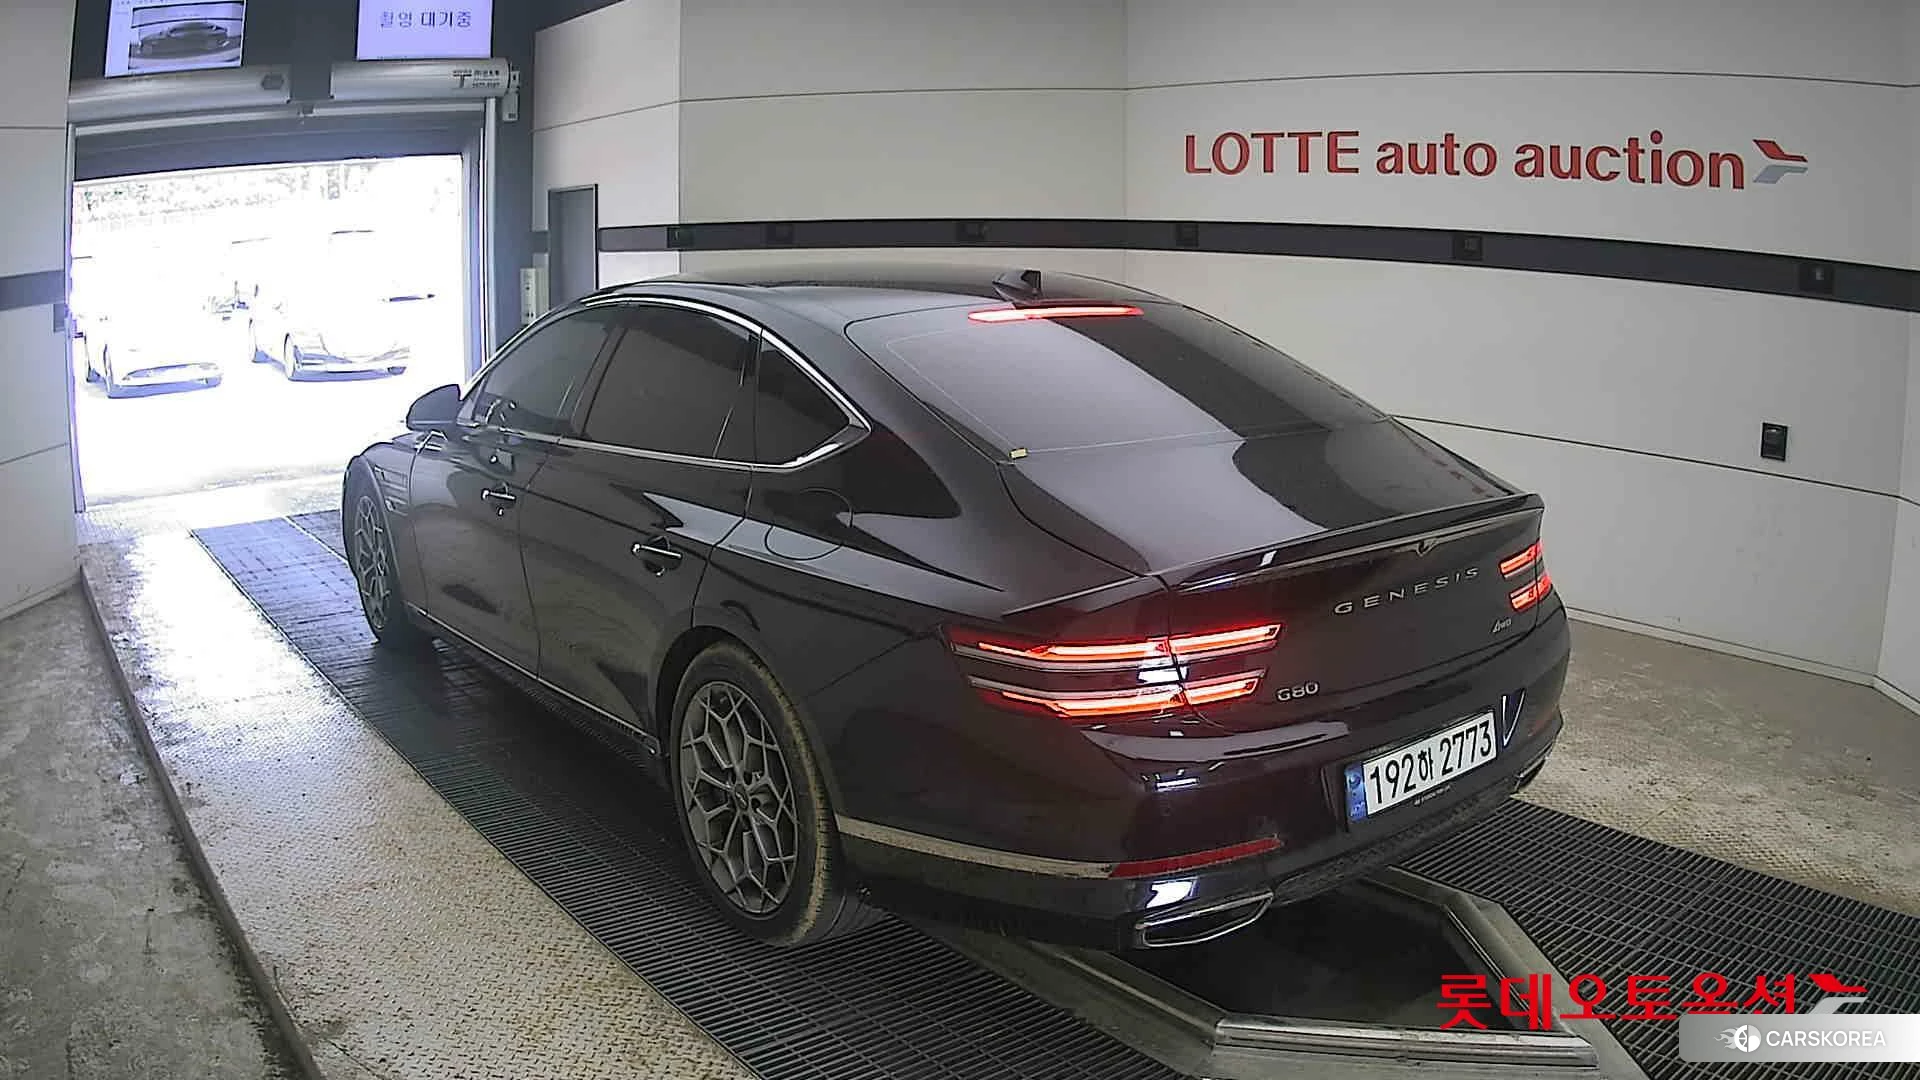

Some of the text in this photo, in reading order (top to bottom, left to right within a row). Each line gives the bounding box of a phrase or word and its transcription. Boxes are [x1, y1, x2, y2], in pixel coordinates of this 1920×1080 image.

[421, 11, 471, 28] 대기중
[1185, 130, 1745, 190] LOTTE auto auction
[1334, 567, 1479, 614] GENESIS
[1277, 682, 1320, 702] G80
[1369, 720, 1492, 805] 192하 2773
